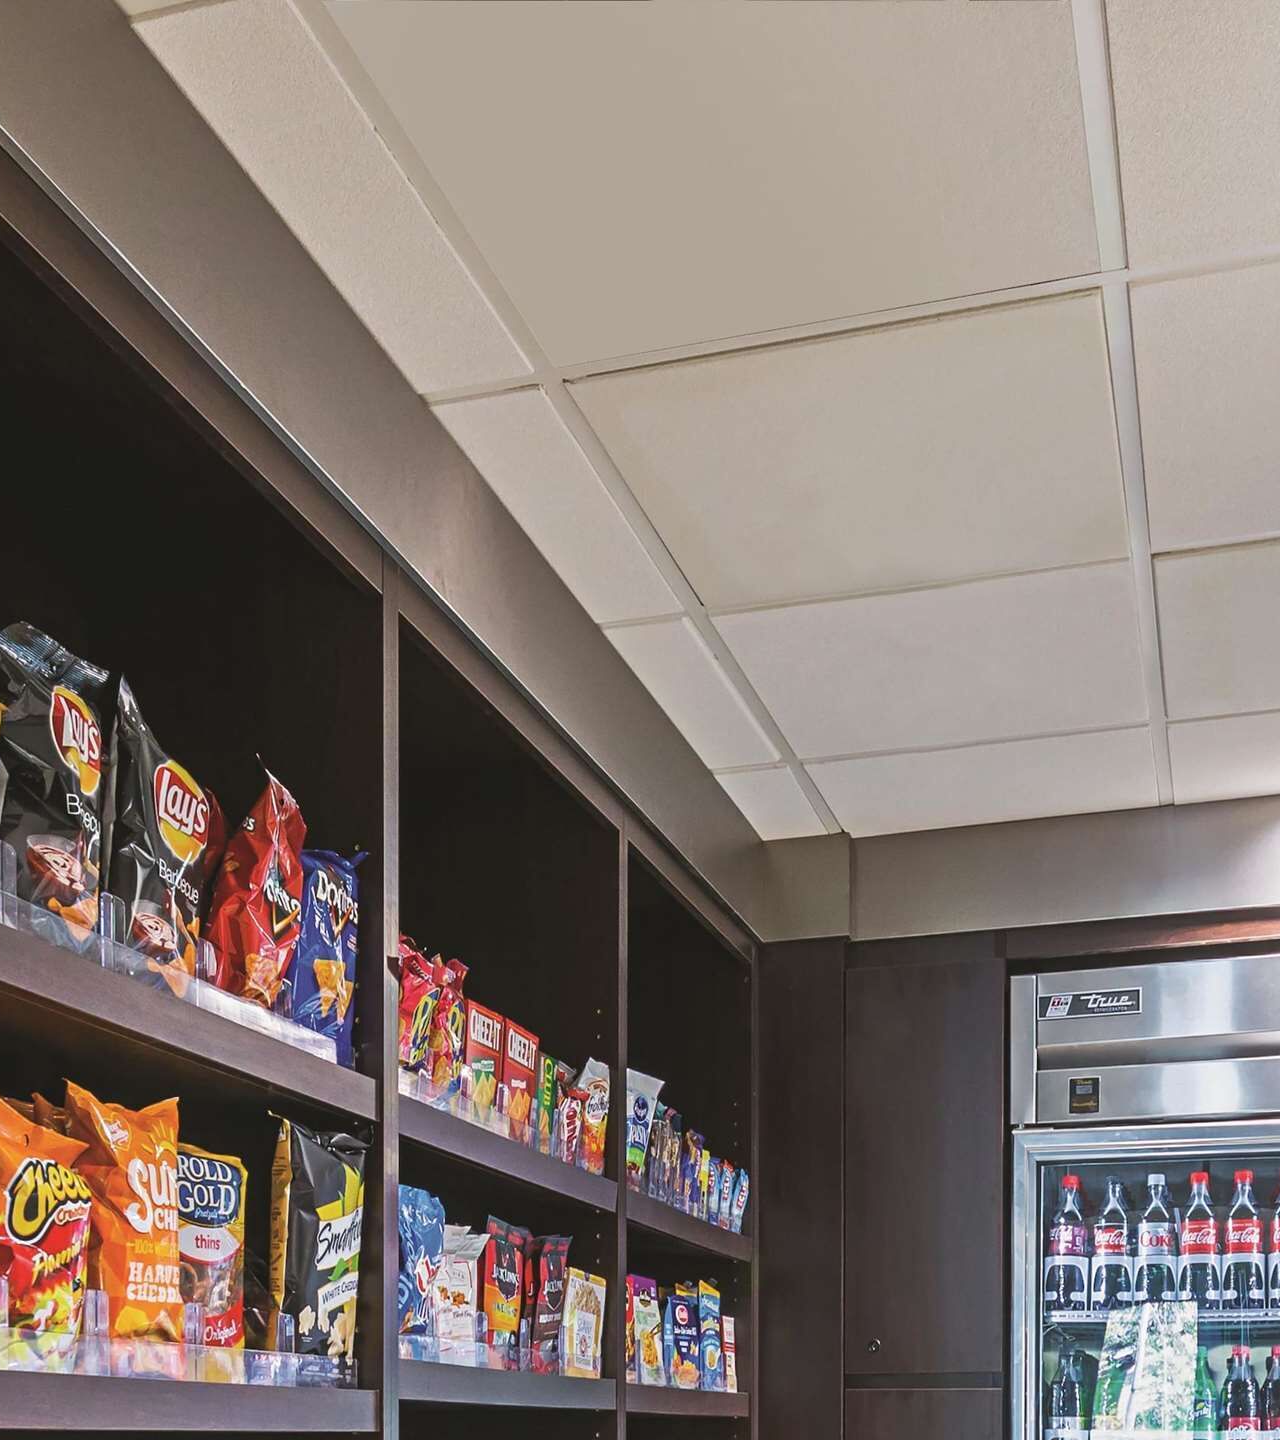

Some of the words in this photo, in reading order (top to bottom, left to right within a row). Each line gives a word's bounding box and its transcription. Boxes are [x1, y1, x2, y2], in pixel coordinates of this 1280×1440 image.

[157, 767, 208, 835] Lay's
[158, 857, 199, 906] Barbecue
[1080, 994, 1137, 1009] true
[470, 1007, 502, 1052] CHEEZ-IT
[507, 1027, 537, 1071] CHEEZ-IT
[178, 1154, 233, 1185] ROLD
[178, 1181, 239, 1214] GOLD
[195, 1233, 220, 1251] thins
[1180, 1226, 1216, 1247] Coca-Cola
[203, 1320, 237, 1347] Original
